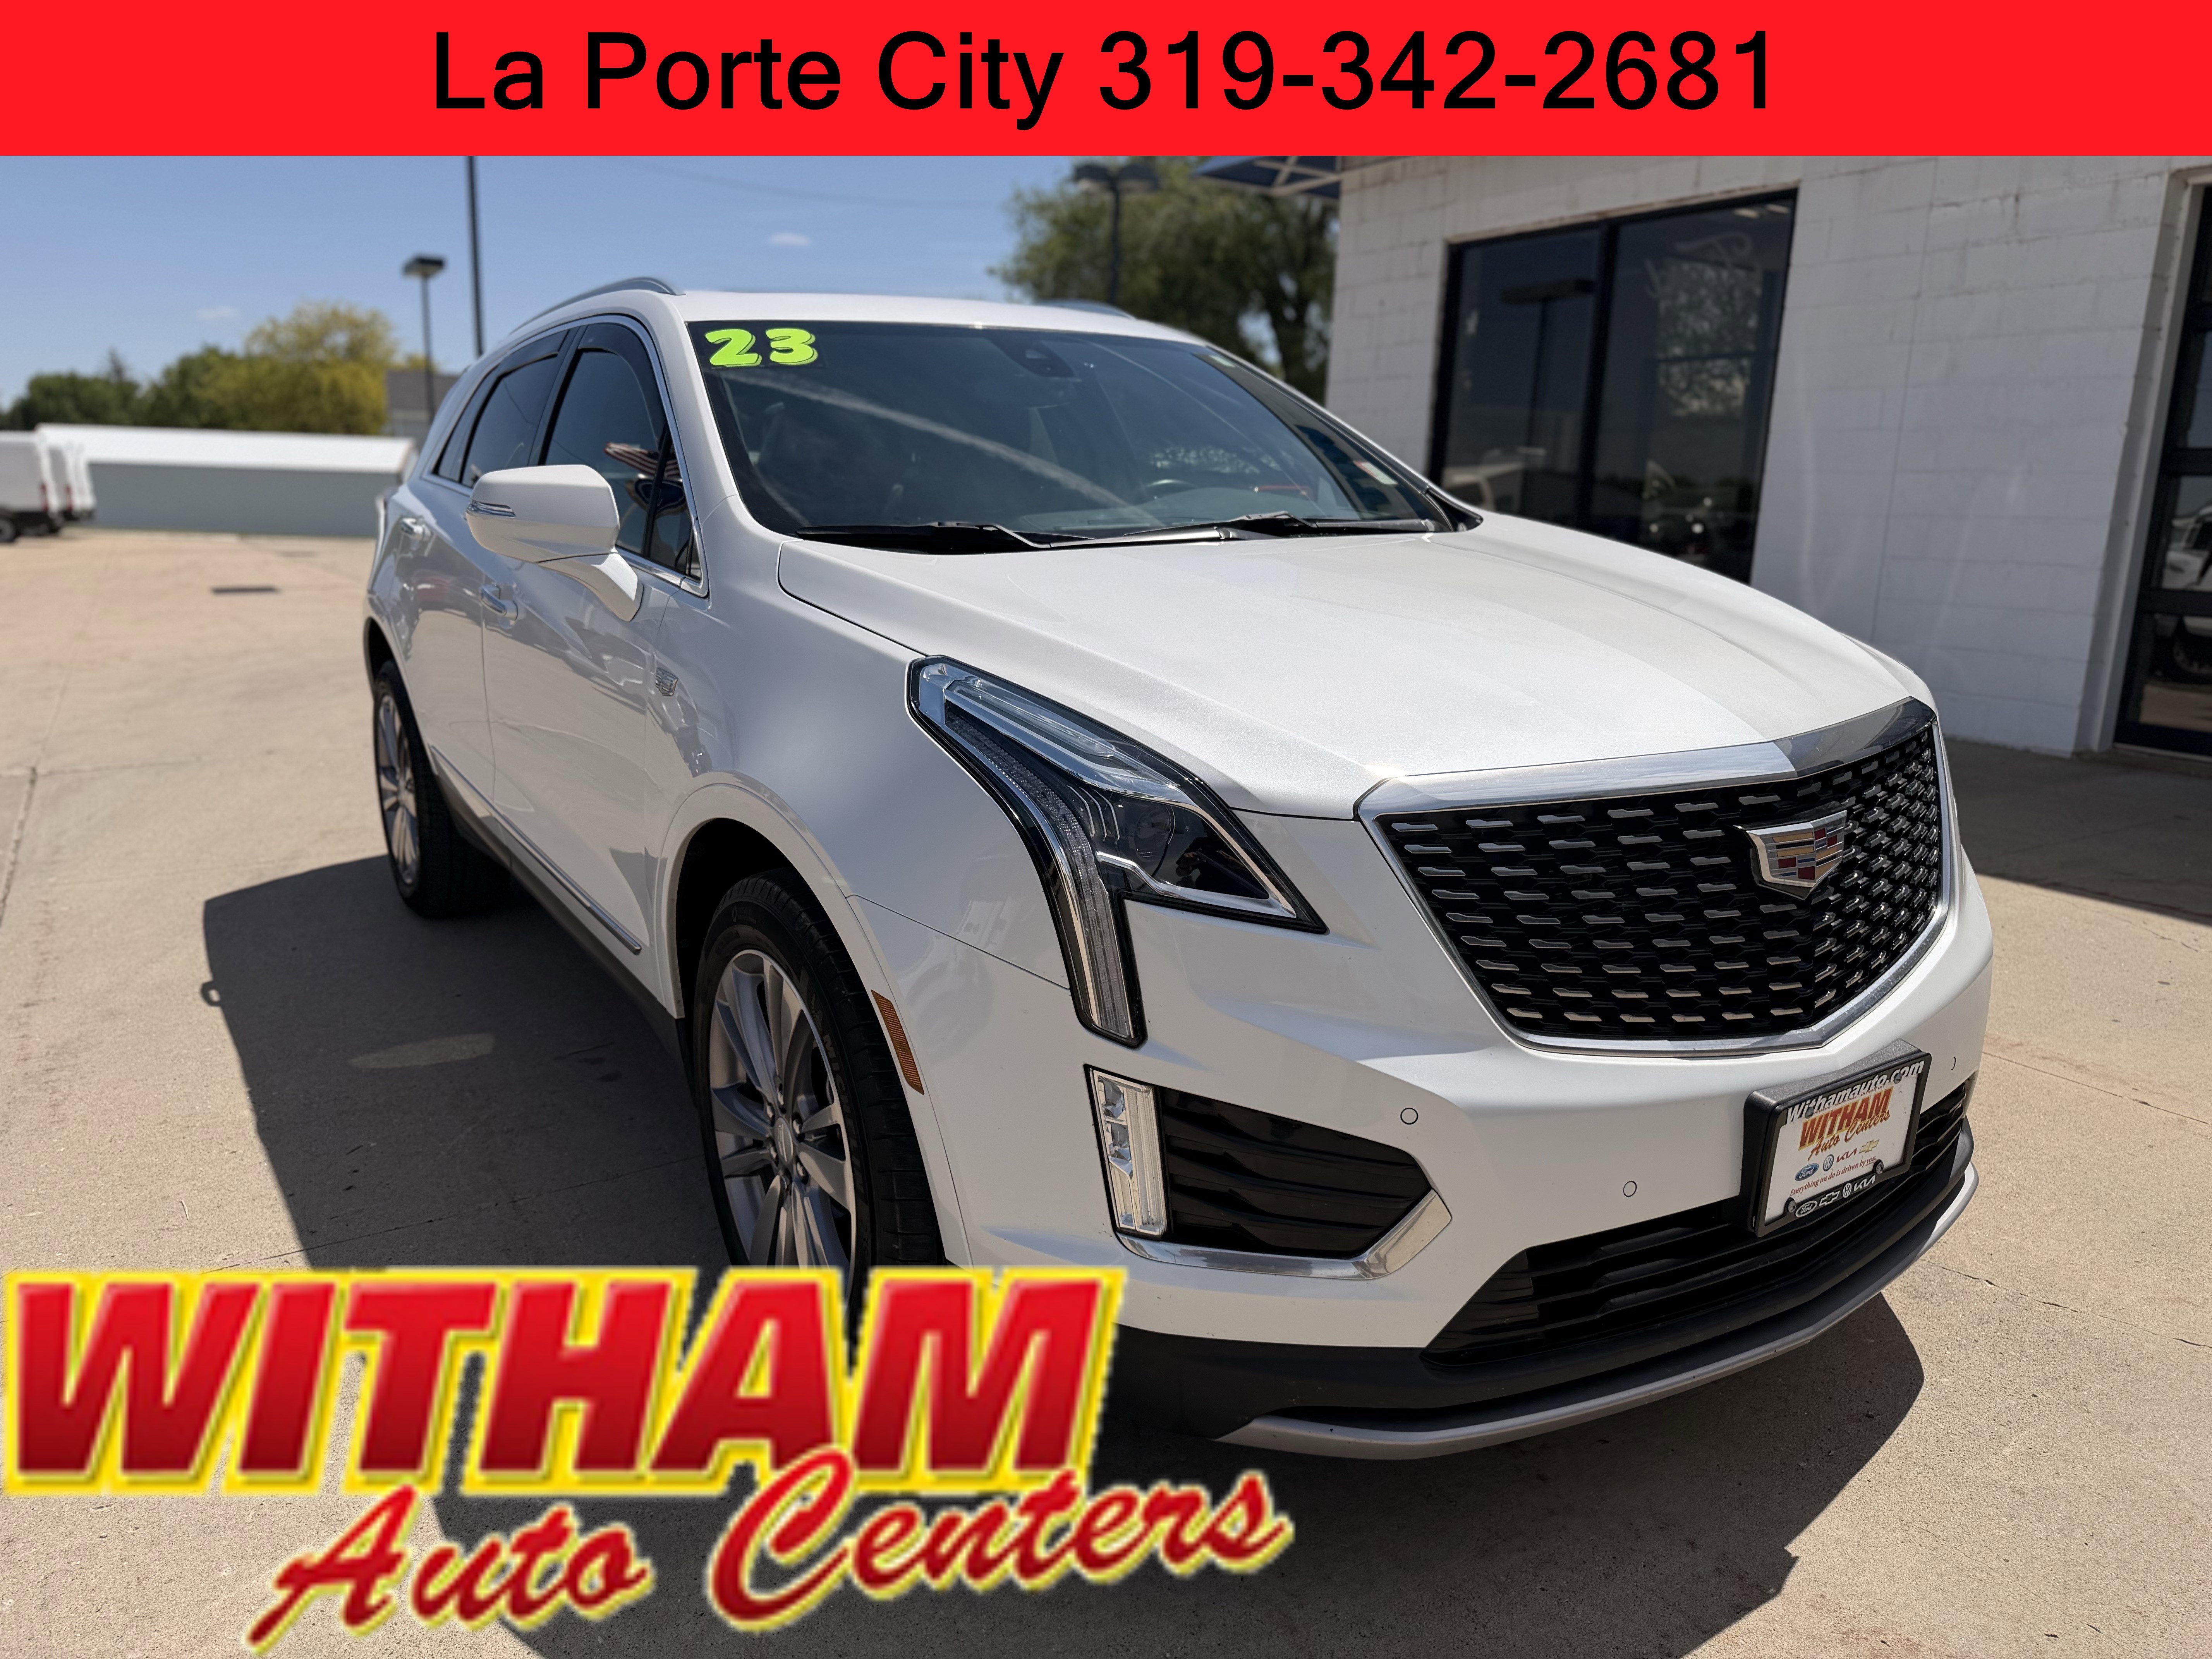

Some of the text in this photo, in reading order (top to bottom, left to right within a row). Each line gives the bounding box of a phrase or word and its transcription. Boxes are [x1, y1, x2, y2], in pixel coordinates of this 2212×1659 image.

[704, 328, 818, 367] 23
[1799, 1087, 1893, 1150] WITHAM
[1807, 1109, 1891, 1161] Auto Centers
[1790, 1179, 1820, 1196] Everything
[1828, 1172, 1835, 1180] do
[1841, 1164, 1859, 1175] driven
[1859, 1159, 1866, 1168] by
[1798, 1166, 1815, 1179] Ford
